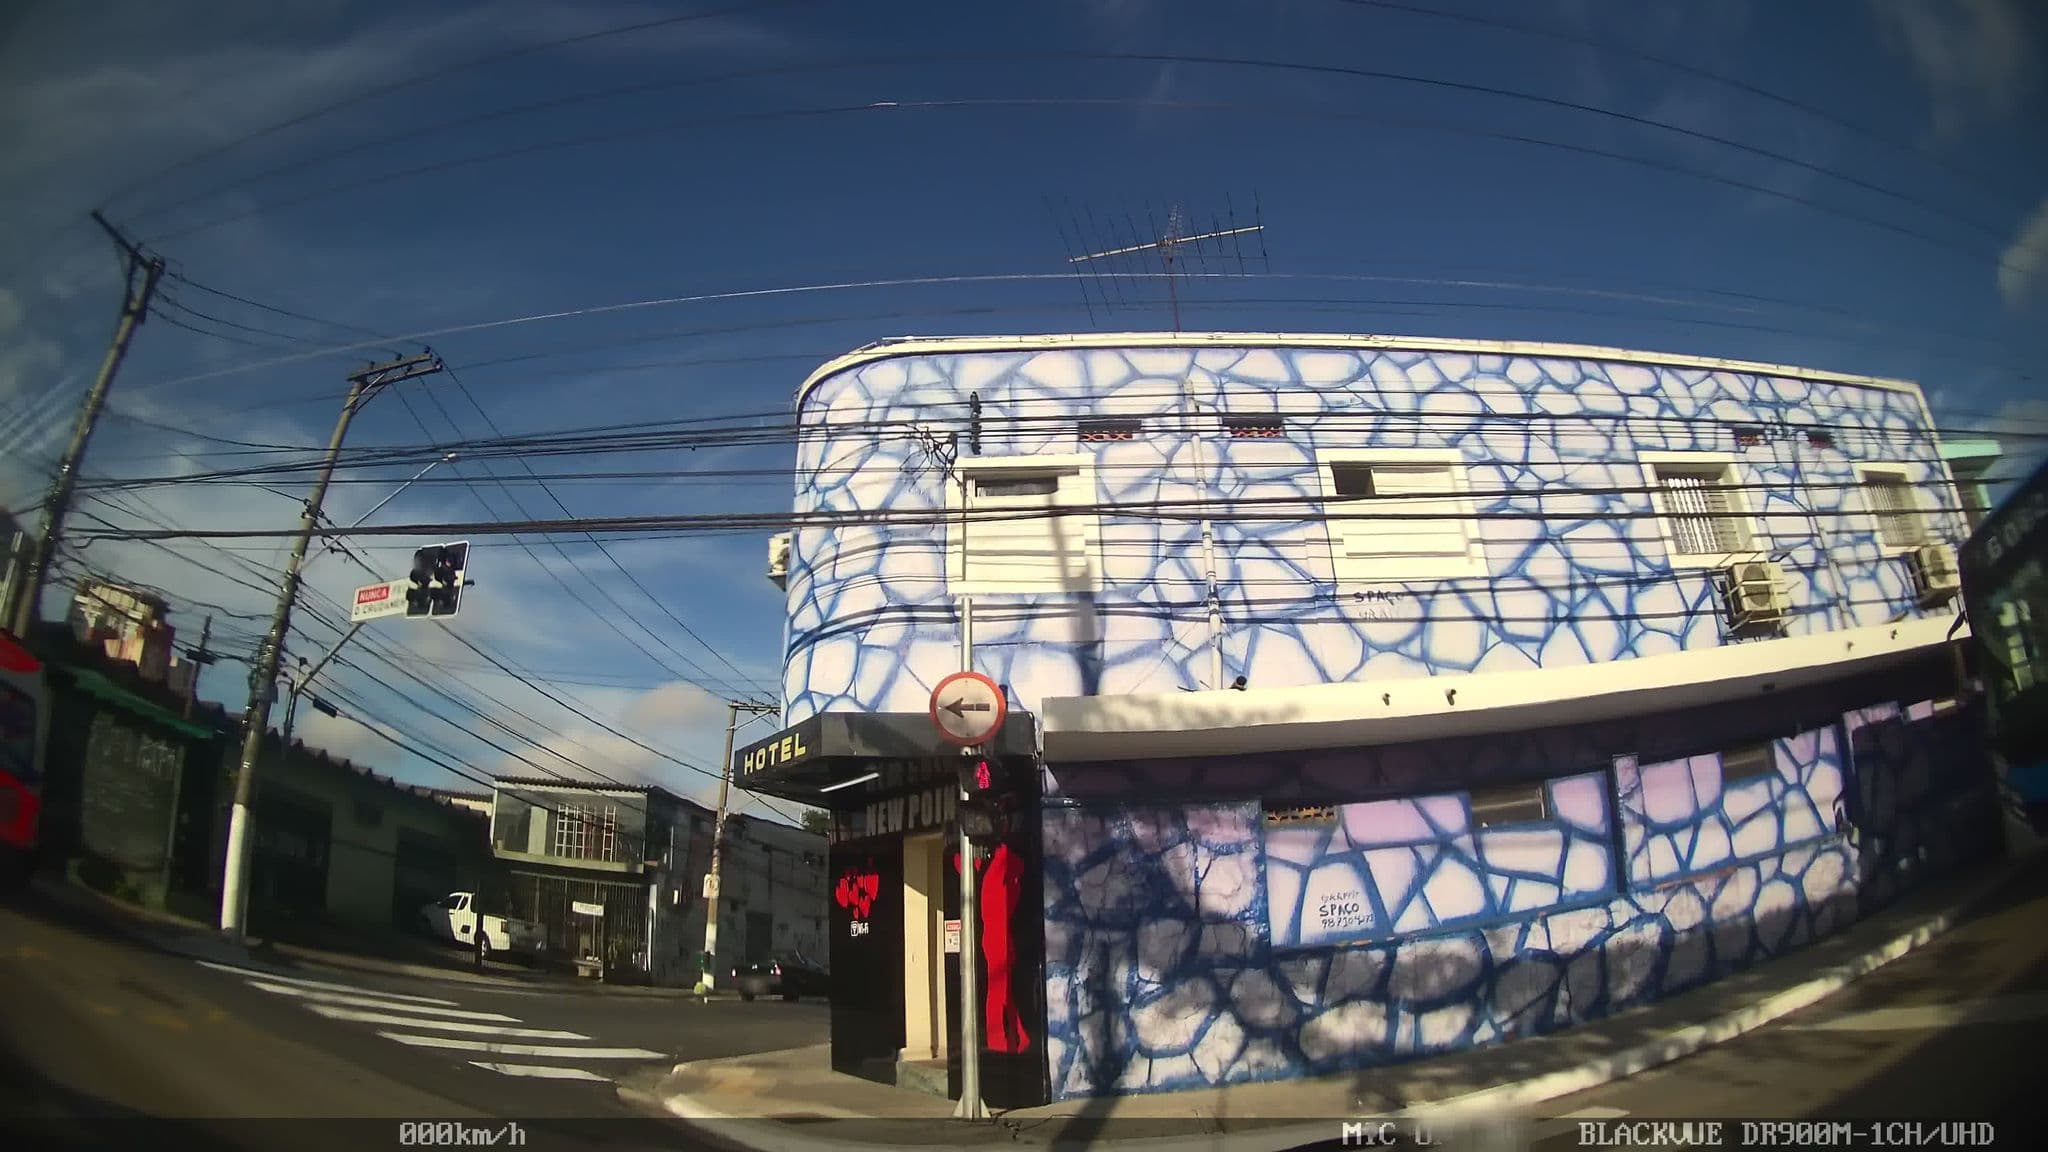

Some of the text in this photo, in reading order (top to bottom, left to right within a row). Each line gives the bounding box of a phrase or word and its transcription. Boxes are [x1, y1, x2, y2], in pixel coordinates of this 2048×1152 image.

[359, 588, 388, 602] NUNCA
[744, 733, 806, 776] HOTEL
[865, 797, 905, 838] NEW
